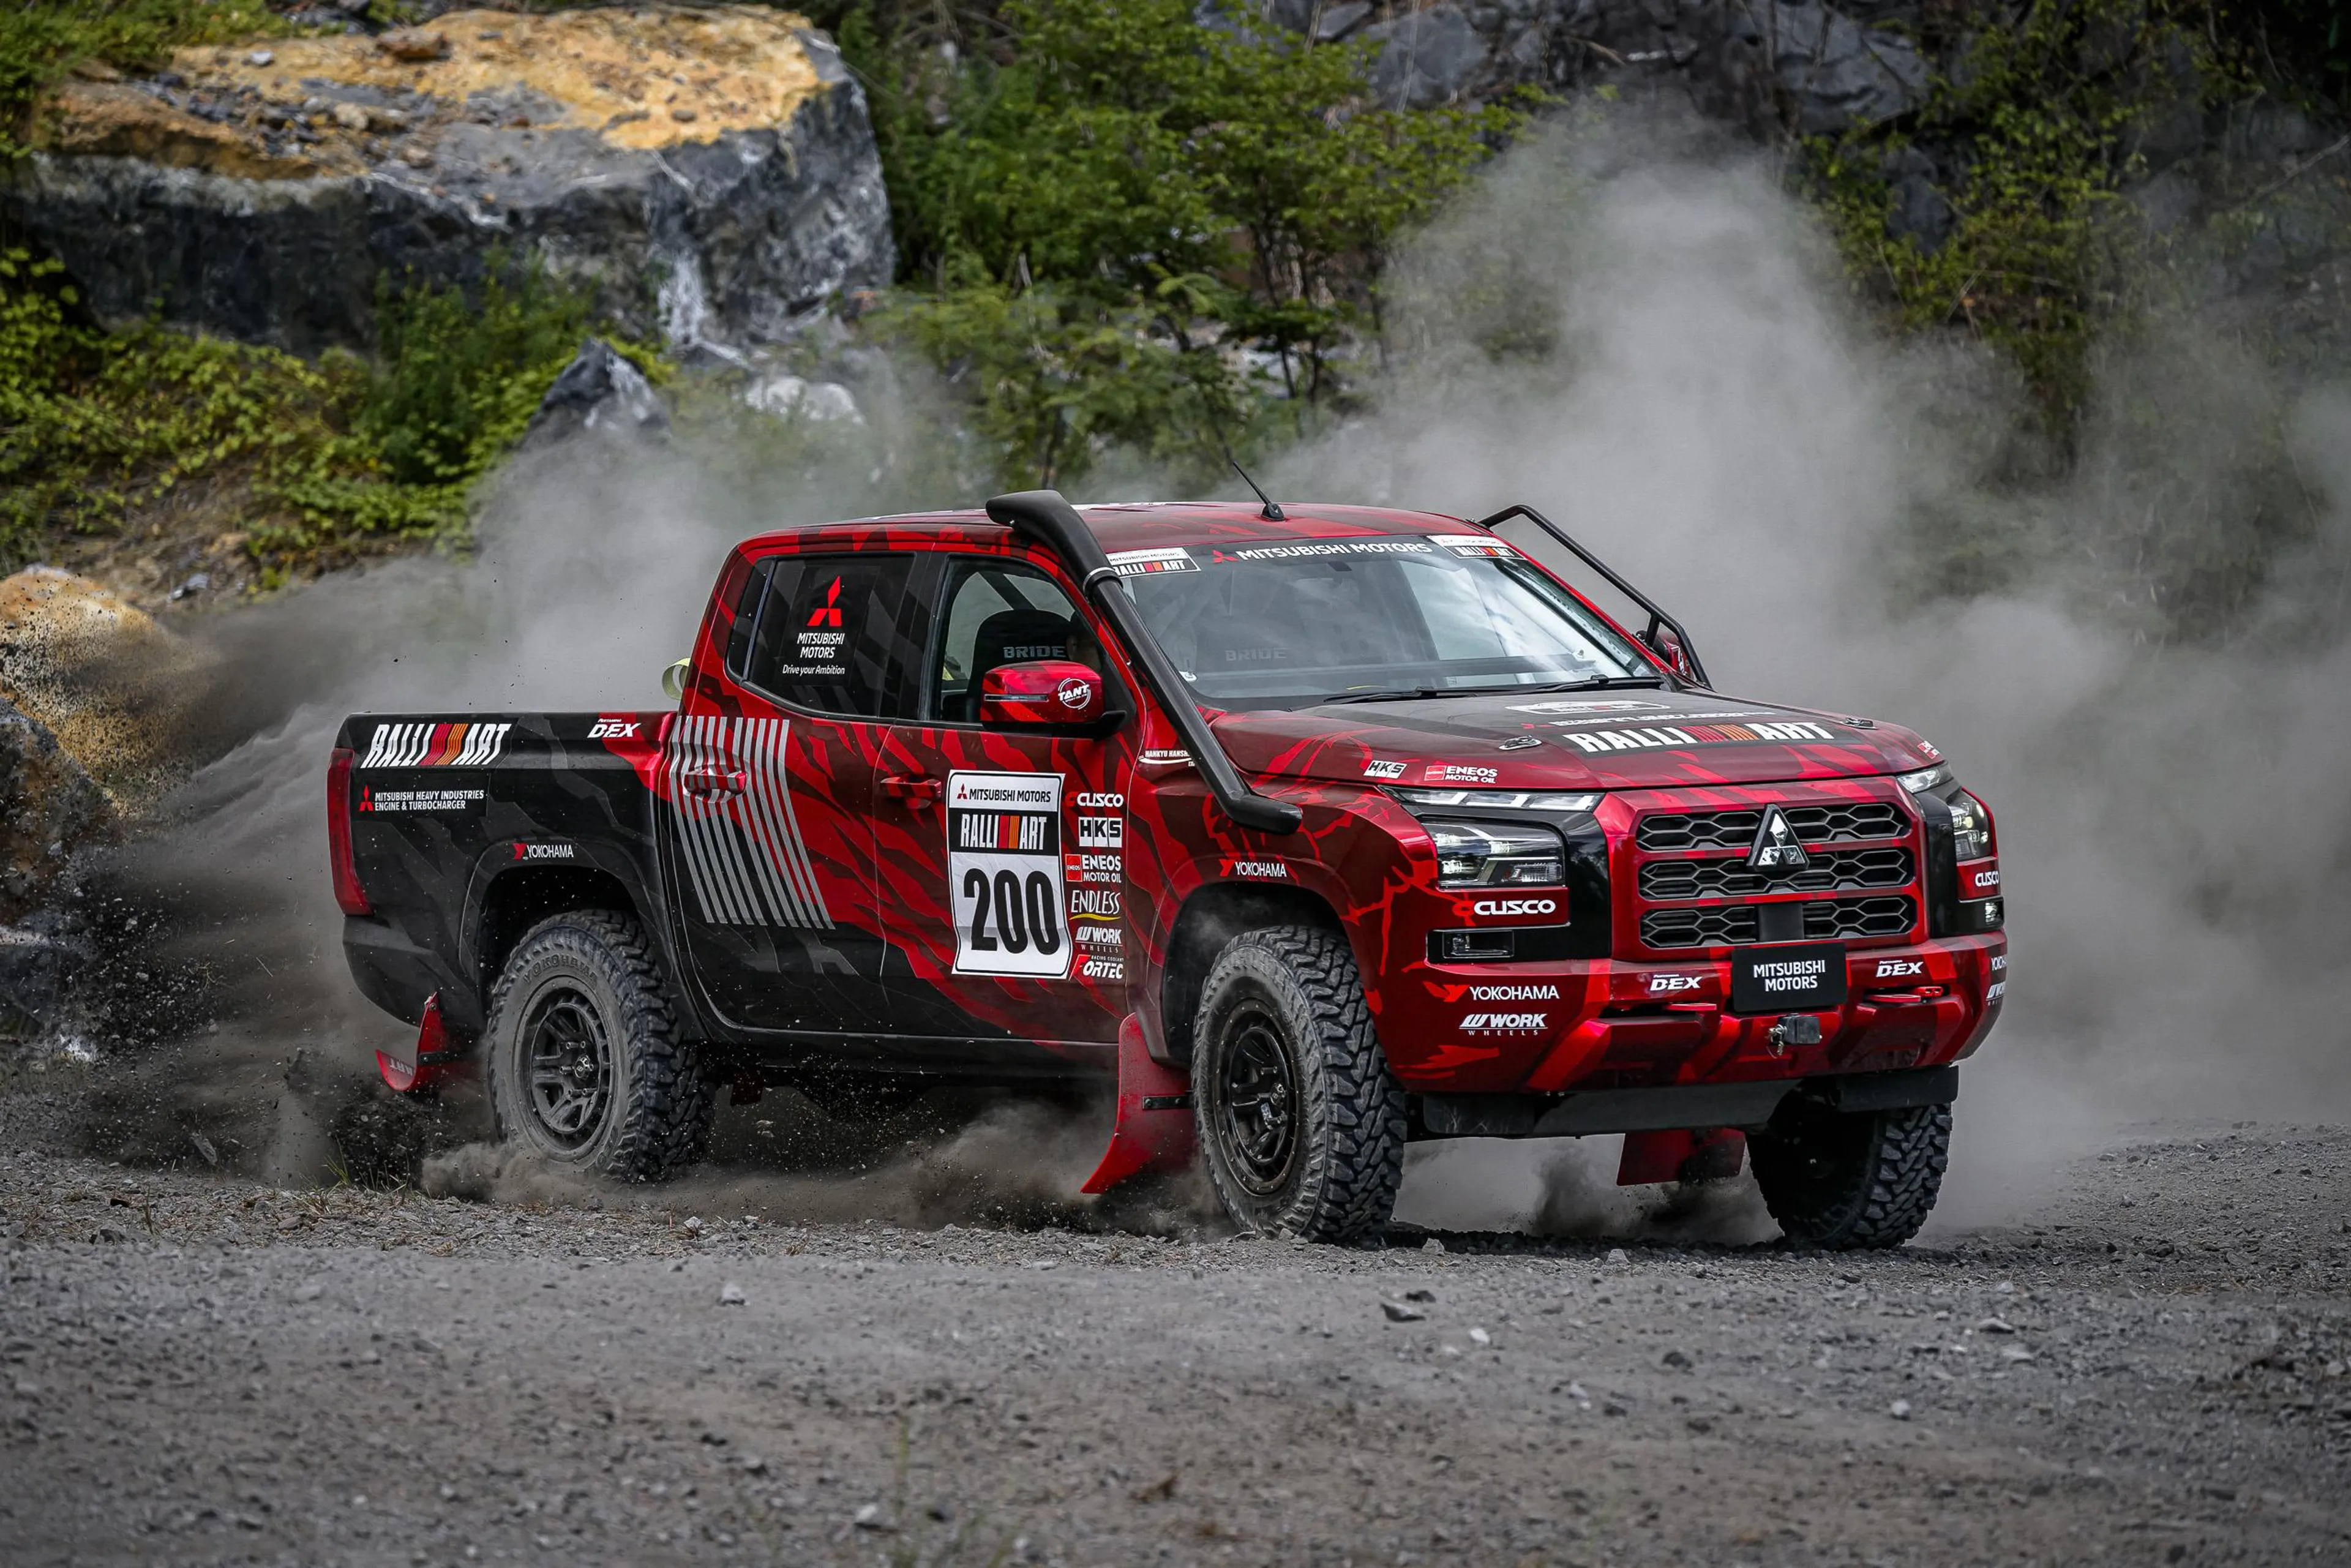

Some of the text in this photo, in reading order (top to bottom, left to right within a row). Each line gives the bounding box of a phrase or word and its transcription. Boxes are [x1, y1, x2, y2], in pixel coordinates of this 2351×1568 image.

[1236, 542, 1433, 560] MITSUBISHI MOTORS
[797, 632, 845, 644] MITSUBISHI
[800, 647, 836, 658] MOTORS
[1003, 646, 1067, 659] BRIDE
[782, 664, 845, 677] Drive your Ambition
[1058, 684, 1090, 701] TANT
[587, 722, 642, 738] DEX
[1368, 762, 1404, 773] HKS
[1445, 765, 1498, 777] ENEOS
[375, 790, 484, 801] MITSUBISHI HEAVY INDUSTRIES
[969, 789, 1051, 802] MITSUBISHI MOTORS
[1077, 792, 1124, 807] CUSCO
[375, 800, 466, 811] ENGINE & TURBOCHARGER
[1079, 819, 1121, 838] HKS
[527, 845, 574, 858] YOKOHAMA
[1082, 855, 1122, 871] ENEOS
[1235, 861, 1287, 877] YOKOHAMA
[1083, 871, 1122, 883] MOTOR OIL
[1071, 890, 1121, 914] ENDLESS
[1474, 899, 1556, 915] CUSCO
[963, 868, 1061, 955] 200
[1081, 944, 1119, 953] WHEELS
[1753, 959, 1826, 978] MITSUBISHI
[1875, 961, 1924, 978] DEX
[1650, 976, 1703, 991] DEX
[1764, 975, 1818, 992] MOTORS
[1469, 985, 1560, 1000] YOKOHAMA
